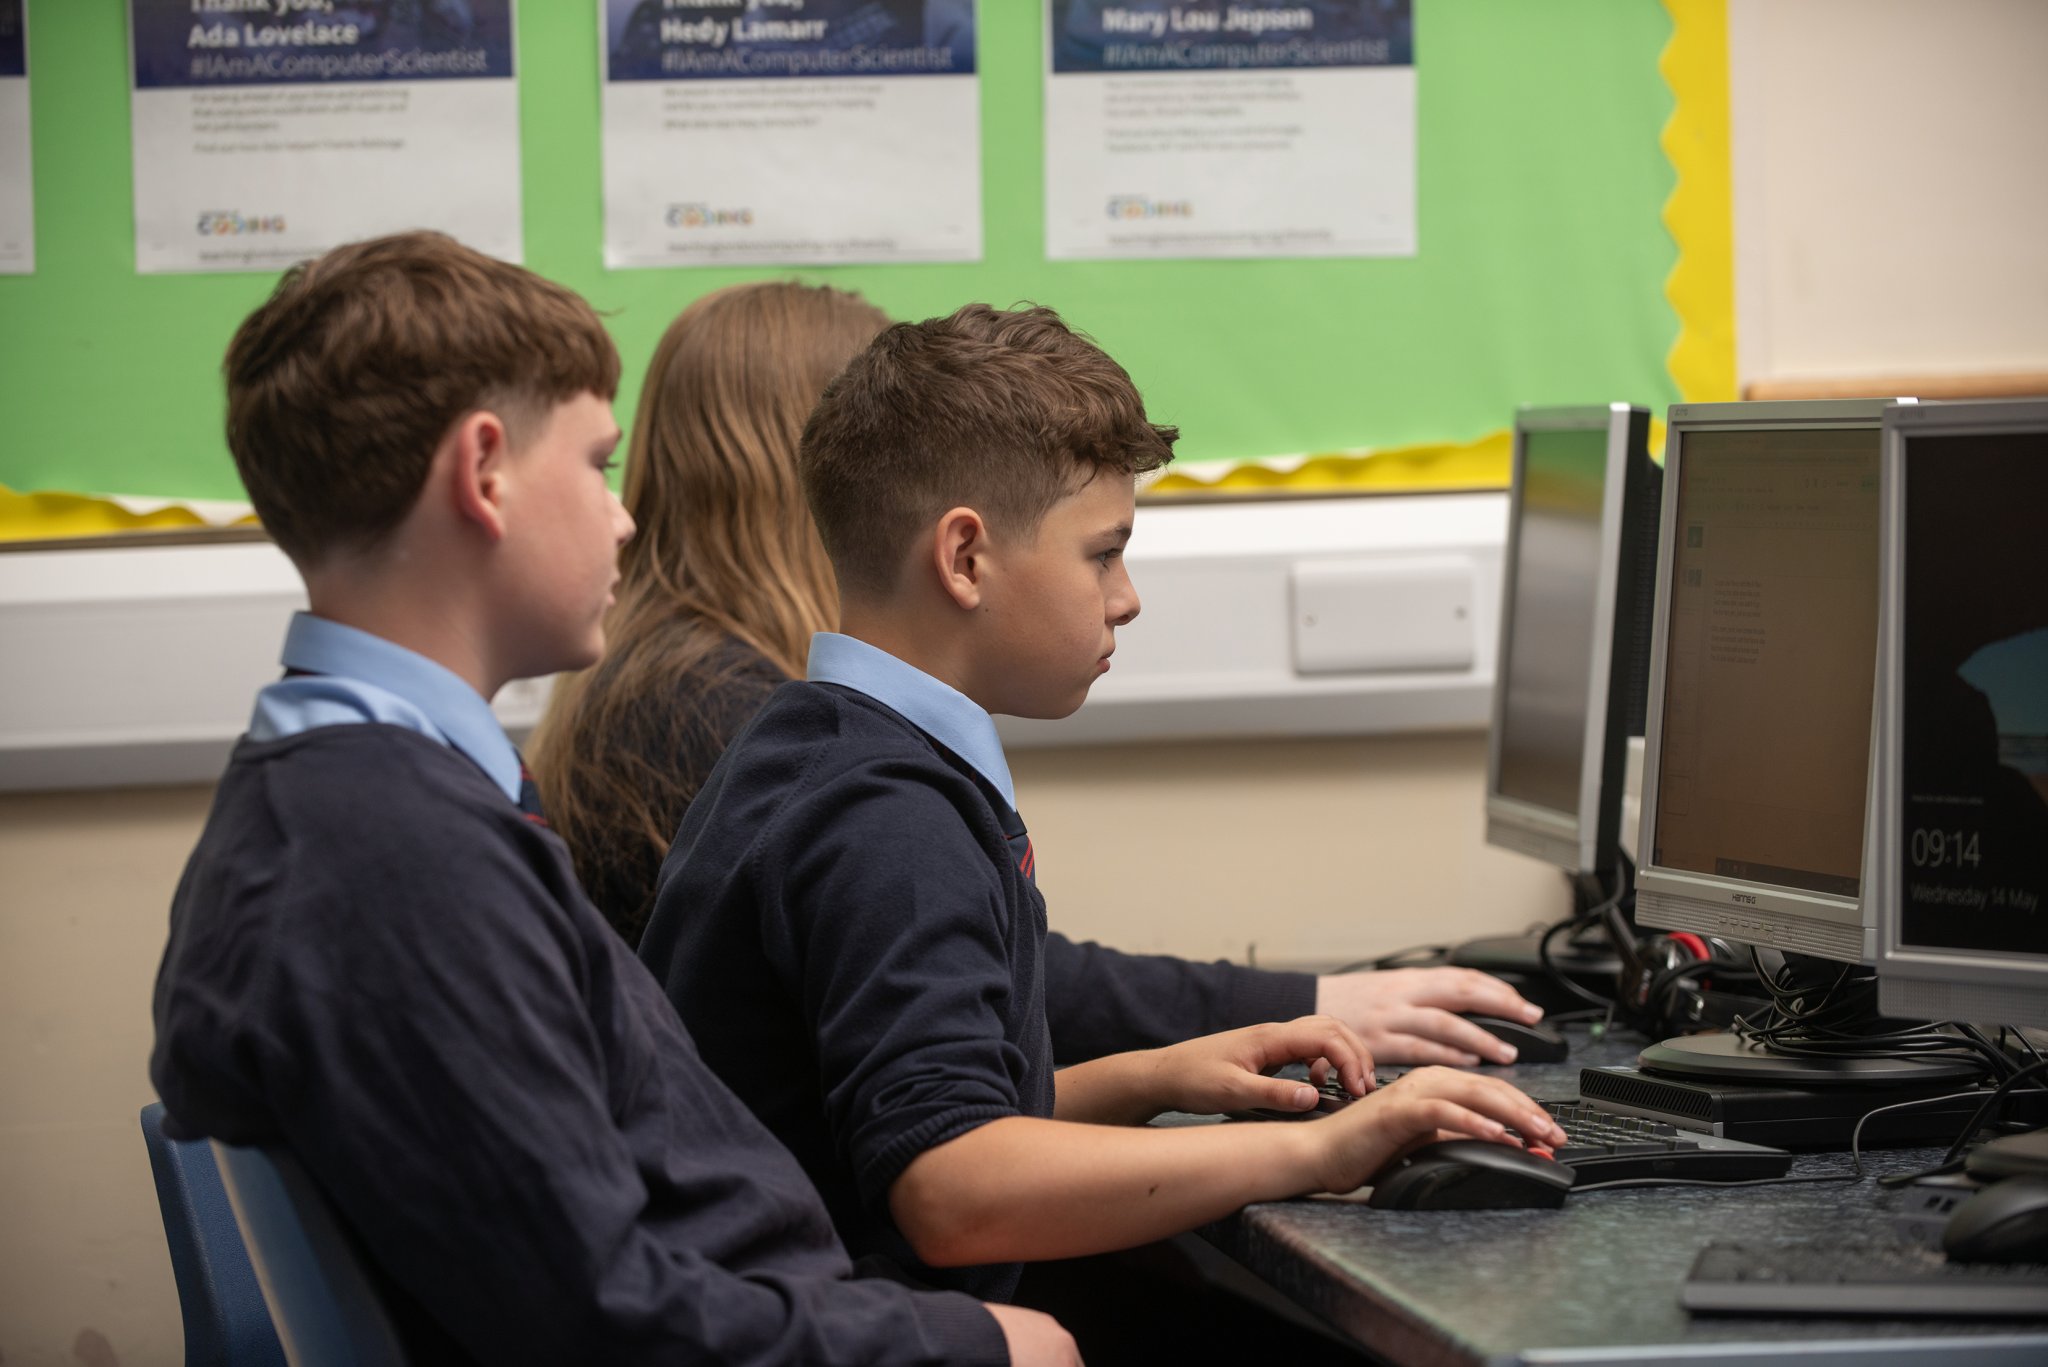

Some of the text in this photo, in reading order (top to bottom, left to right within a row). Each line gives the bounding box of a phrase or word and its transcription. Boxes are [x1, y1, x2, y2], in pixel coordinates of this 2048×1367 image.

[188, 19, 360, 48] Ada Lovelace
[660, 15, 828, 47] Hedy Lamarr
[1102, 5, 1314, 38] Mary Lou Jepsen
[191, 47, 487, 78] #IAmAComputerScientist
[661, 44, 954, 73] #IAmAComputerScientist
[1102, 38, 1390, 67] #IAmAComputerScientist
[1911, 827, 1983, 870] 09:14
[1911, 881, 2040, 916] Wednesday 14 May
